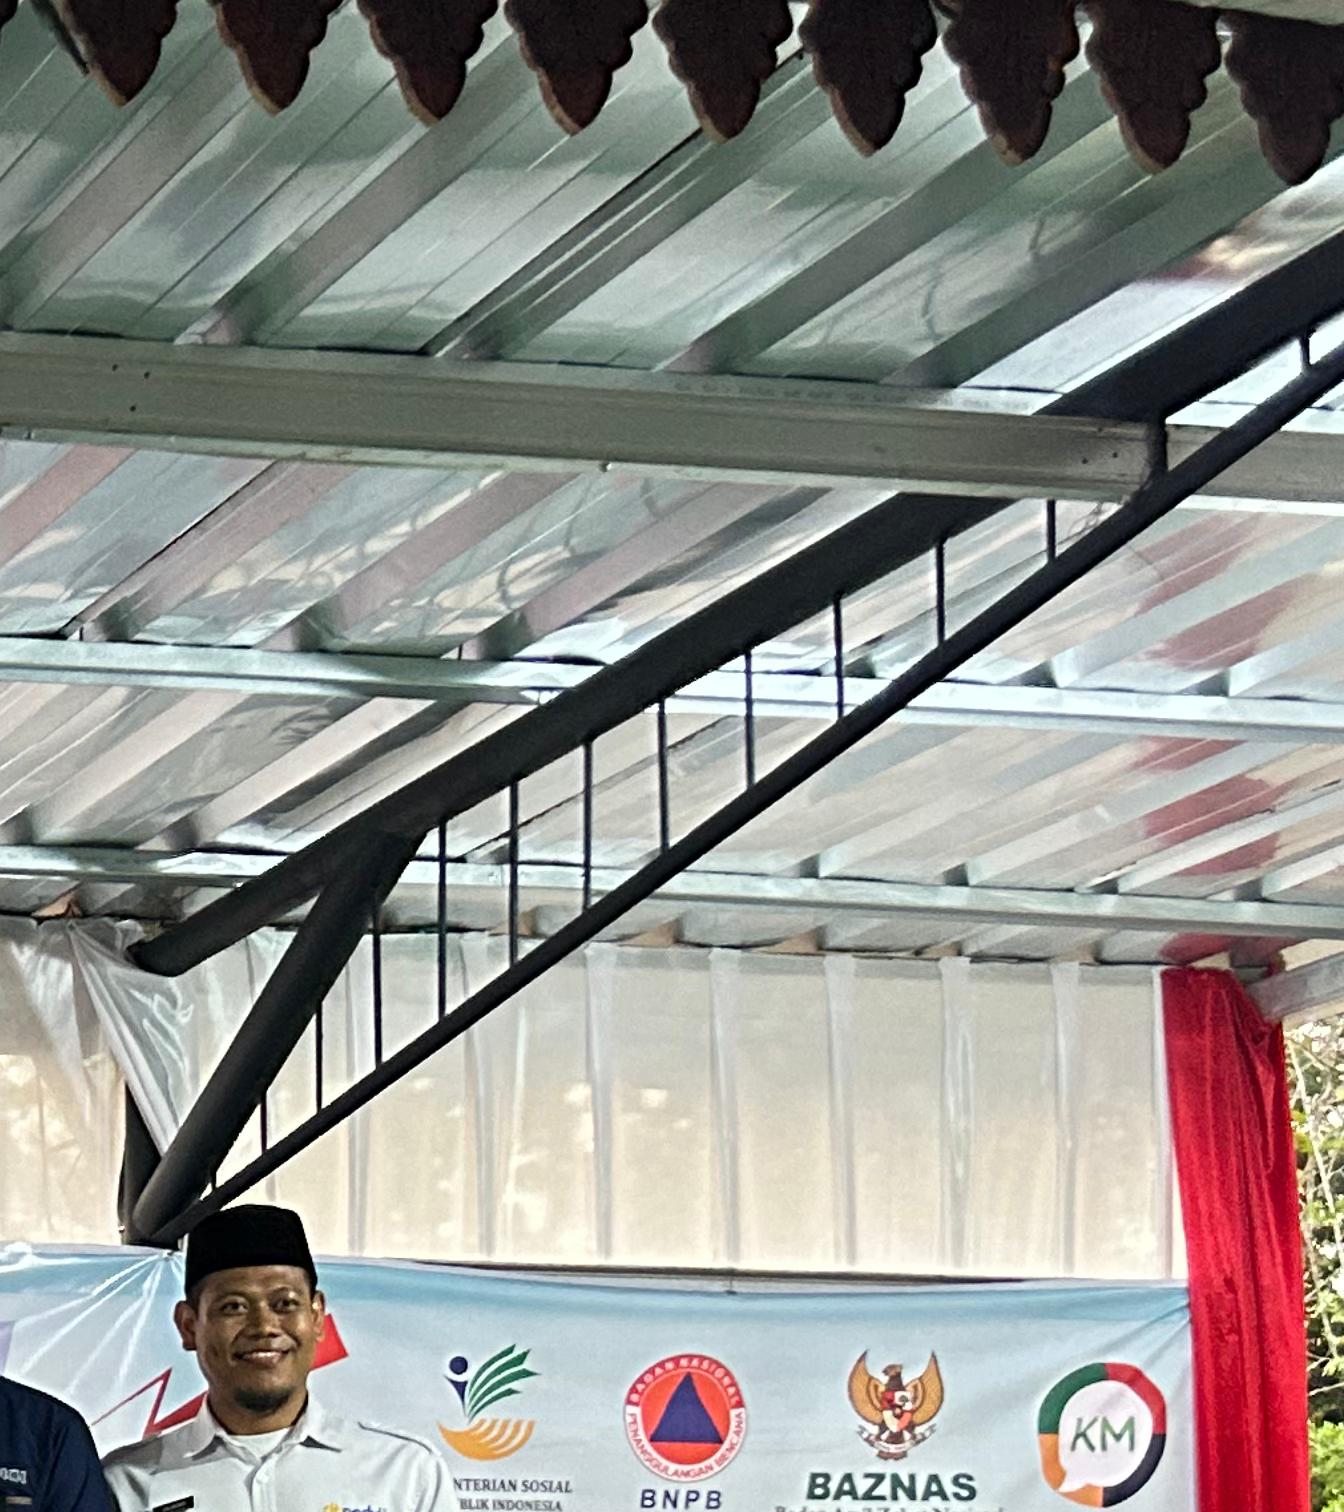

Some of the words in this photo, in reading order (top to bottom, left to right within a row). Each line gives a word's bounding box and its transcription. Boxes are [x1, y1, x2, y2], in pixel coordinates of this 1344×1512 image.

[1069, 1416, 1136, 1453] KM
[521, 1479, 573, 1494] SOSIAL
[807, 1472, 977, 1502] BAZNAS
[492, 1499, 563, 1512] INDONESIA
[640, 1488, 723, 1510] BNPB
